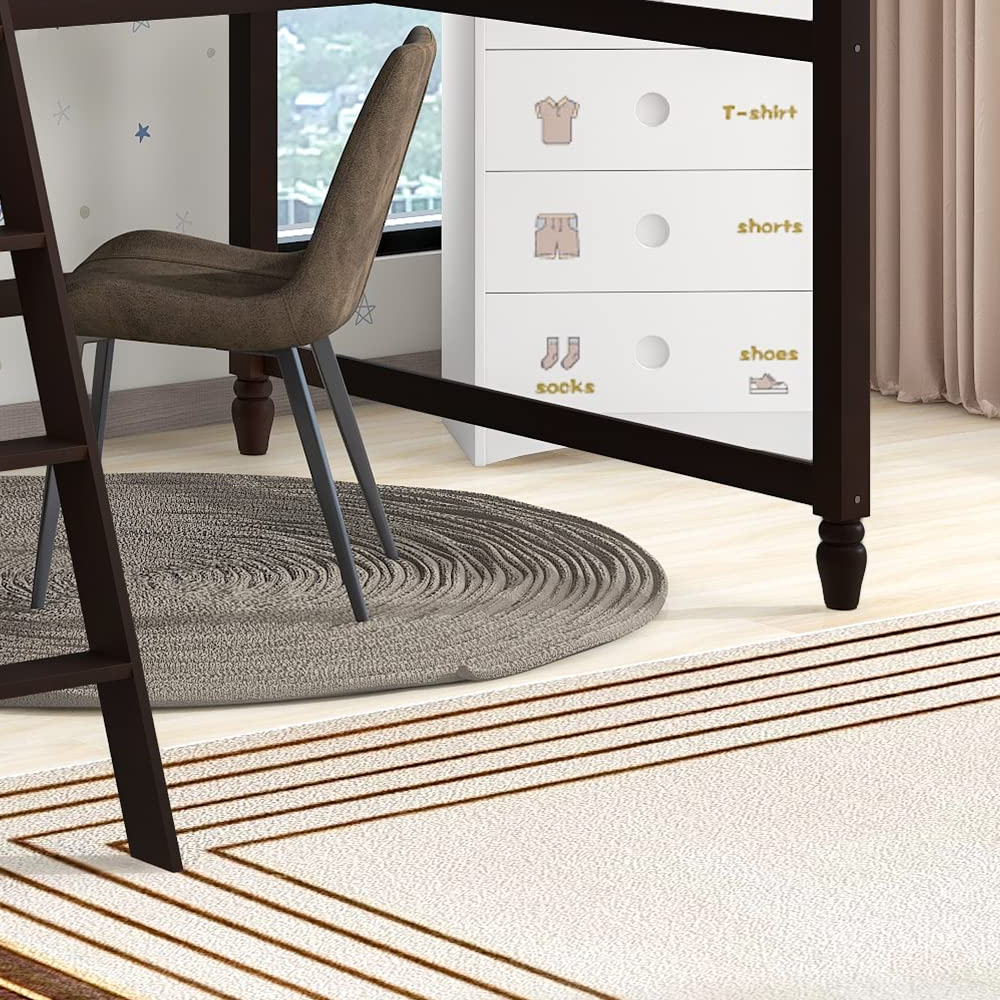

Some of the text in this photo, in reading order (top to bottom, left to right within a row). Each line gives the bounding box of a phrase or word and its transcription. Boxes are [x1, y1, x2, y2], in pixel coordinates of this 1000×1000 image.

[722, 104, 798, 121] T-shirt
[737, 218, 803, 234] shorts
[739, 345, 799, 361] shoes
[535, 378, 595, 395] socks
